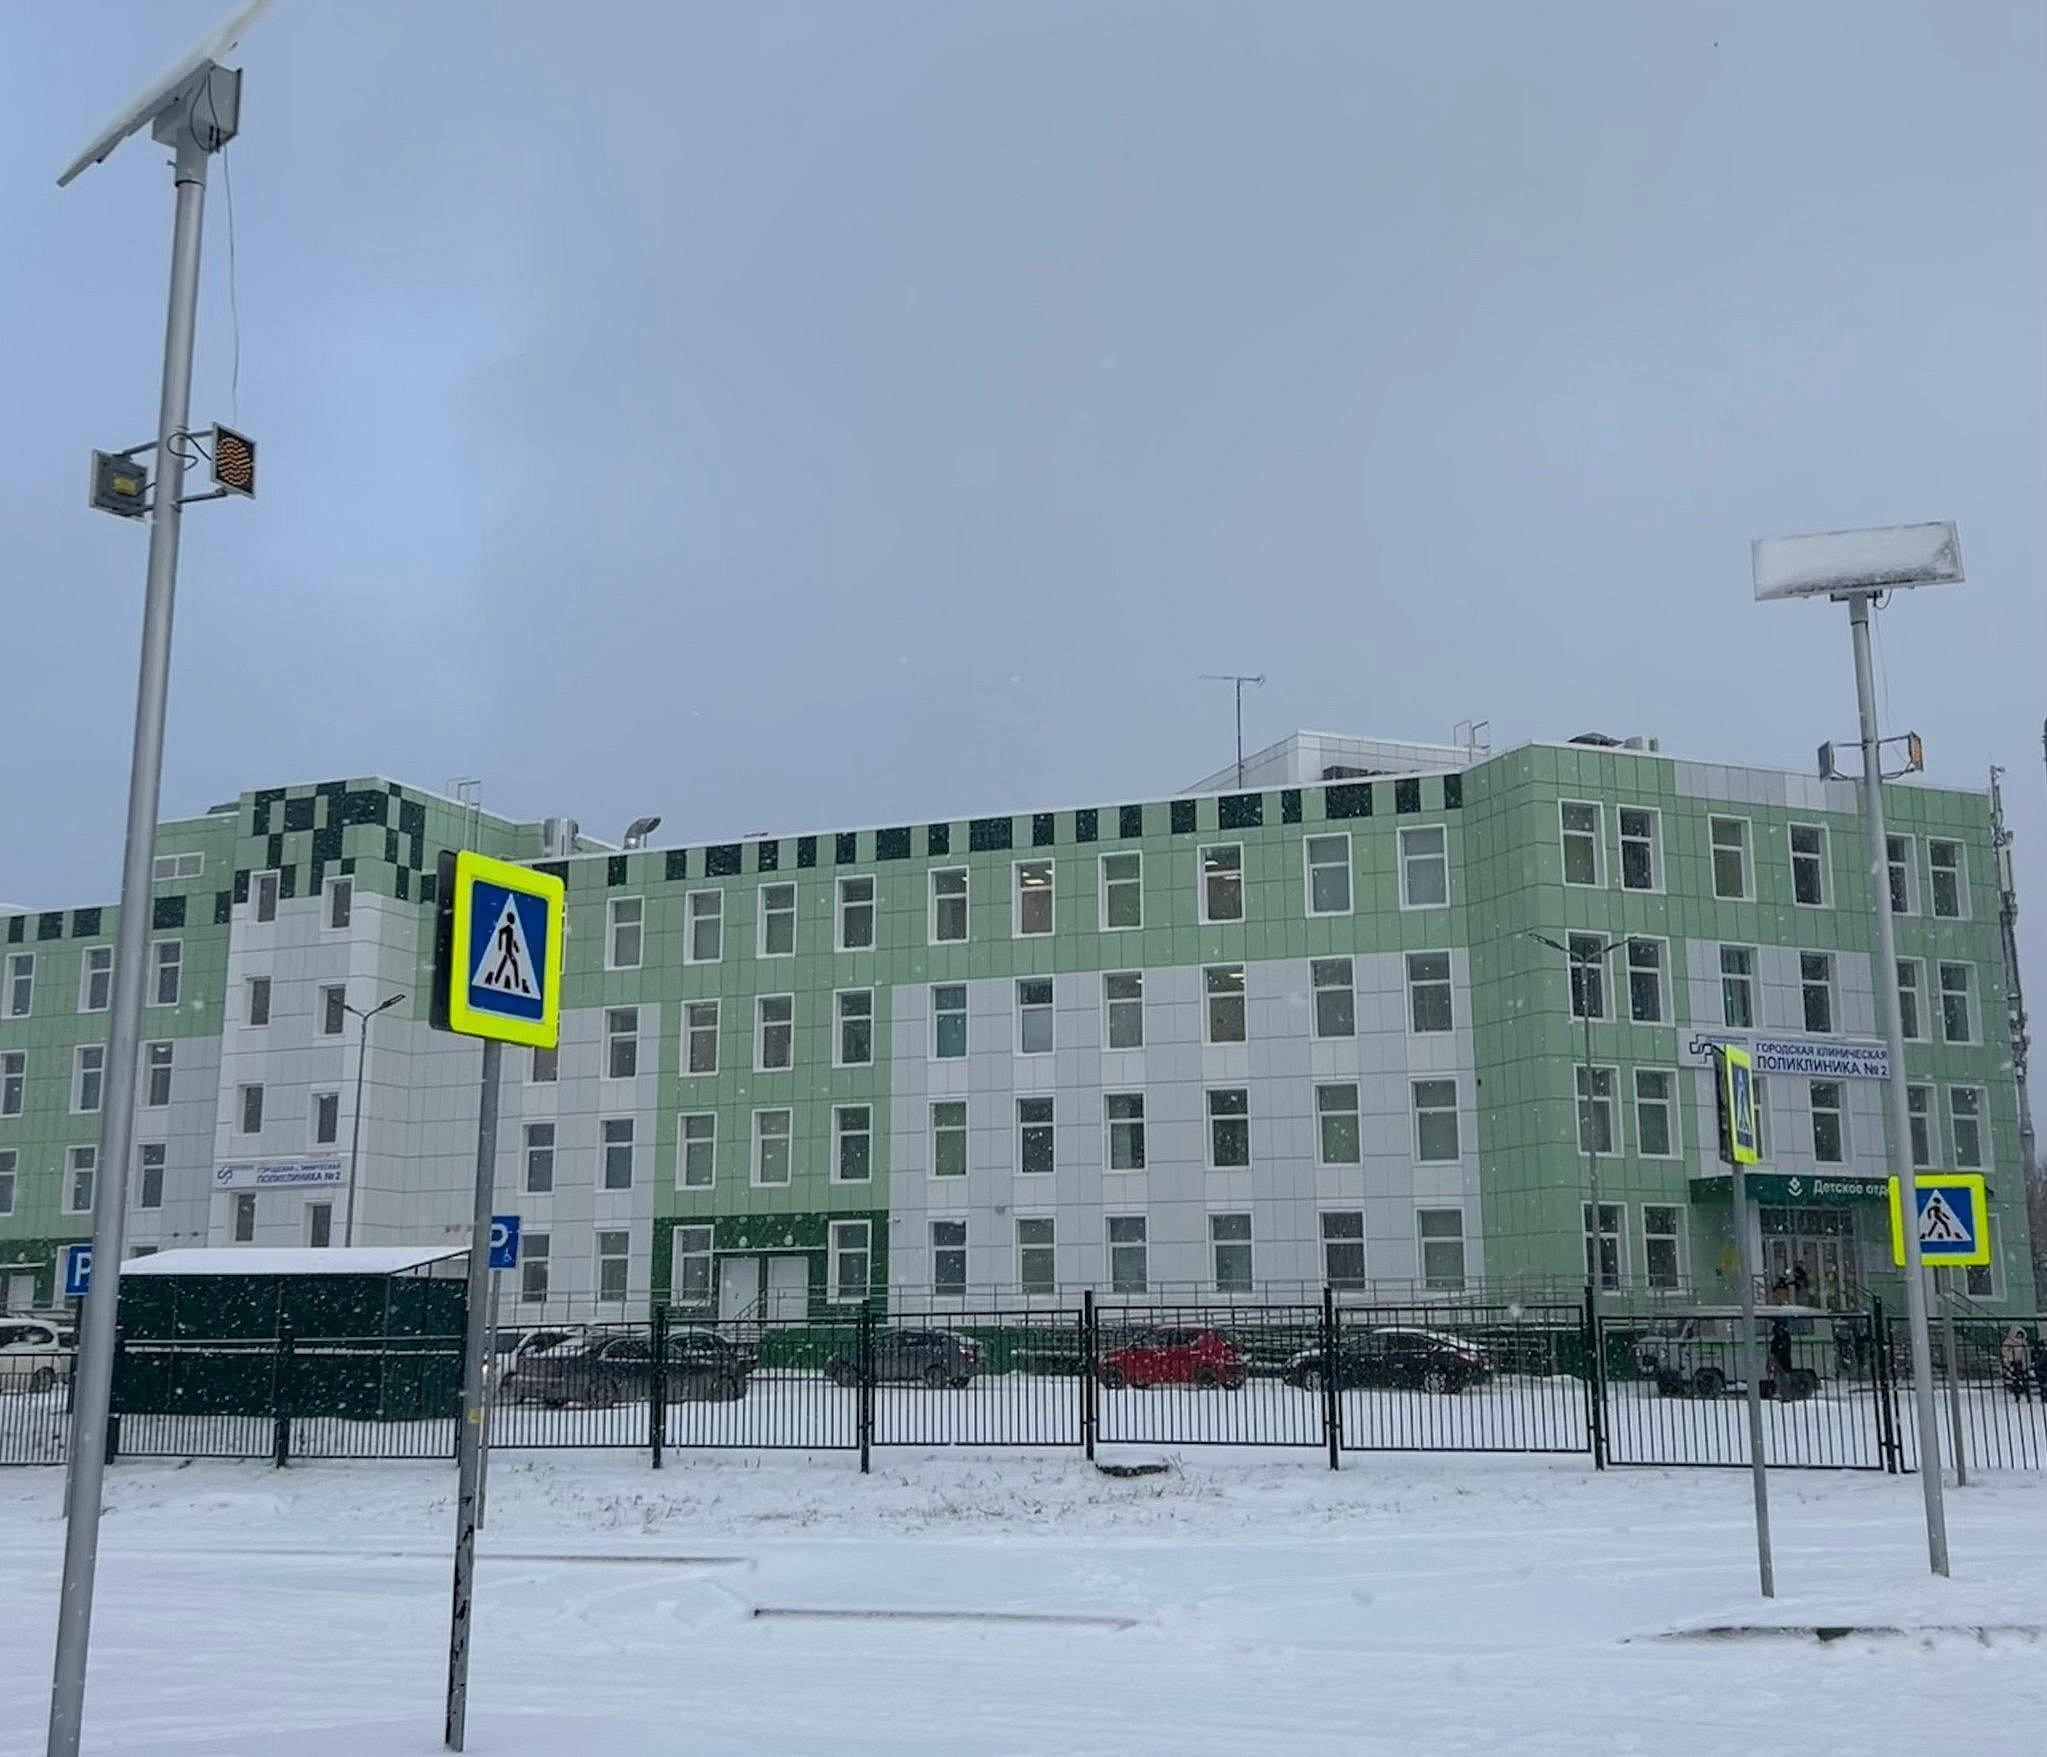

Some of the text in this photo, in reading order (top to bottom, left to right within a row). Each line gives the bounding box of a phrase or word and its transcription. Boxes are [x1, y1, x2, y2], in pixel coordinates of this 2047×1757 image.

[1756, 1042, 1888, 1060] ГОРОДСКАЯ КЛИНИЧЕСКАЯ
[1757, 1055, 1860, 1074] ПОЛИКЛИНИКА
[1813, 1179, 1889, 1199] Детское отд
[74, 1252, 92, 1287] P
